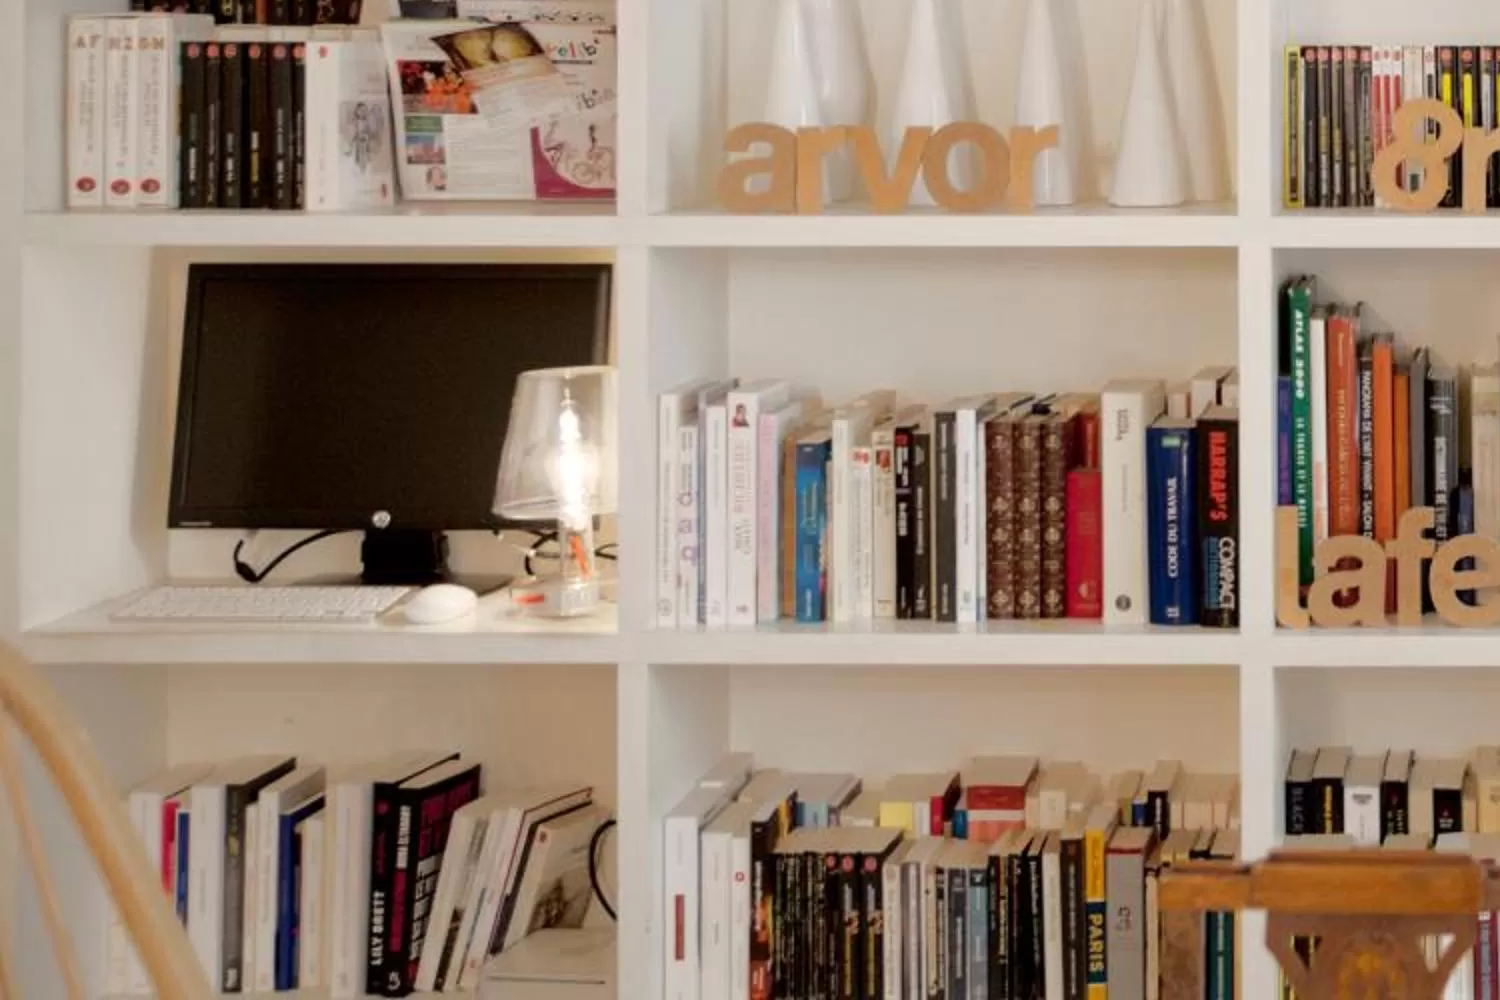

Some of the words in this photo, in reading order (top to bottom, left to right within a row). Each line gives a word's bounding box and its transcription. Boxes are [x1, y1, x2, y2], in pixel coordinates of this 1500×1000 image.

[717, 120, 1059, 216] arvor
[1295, 309, 1304, 353] ATLAS
[1209, 431, 1229, 520] HARRAP'S
[1167, 478, 1177, 520] TRAVAIL
[1167, 524, 1177, 543] DU
[1168, 545, 1178, 576] CODE
[1219, 536, 1235, 609] COMPACT
[1292, 787, 1304, 833] BLACK
[372, 891, 385, 933] BRETT
[371, 937, 383, 965] LILY
[1088, 912, 1105, 973] PARIS
